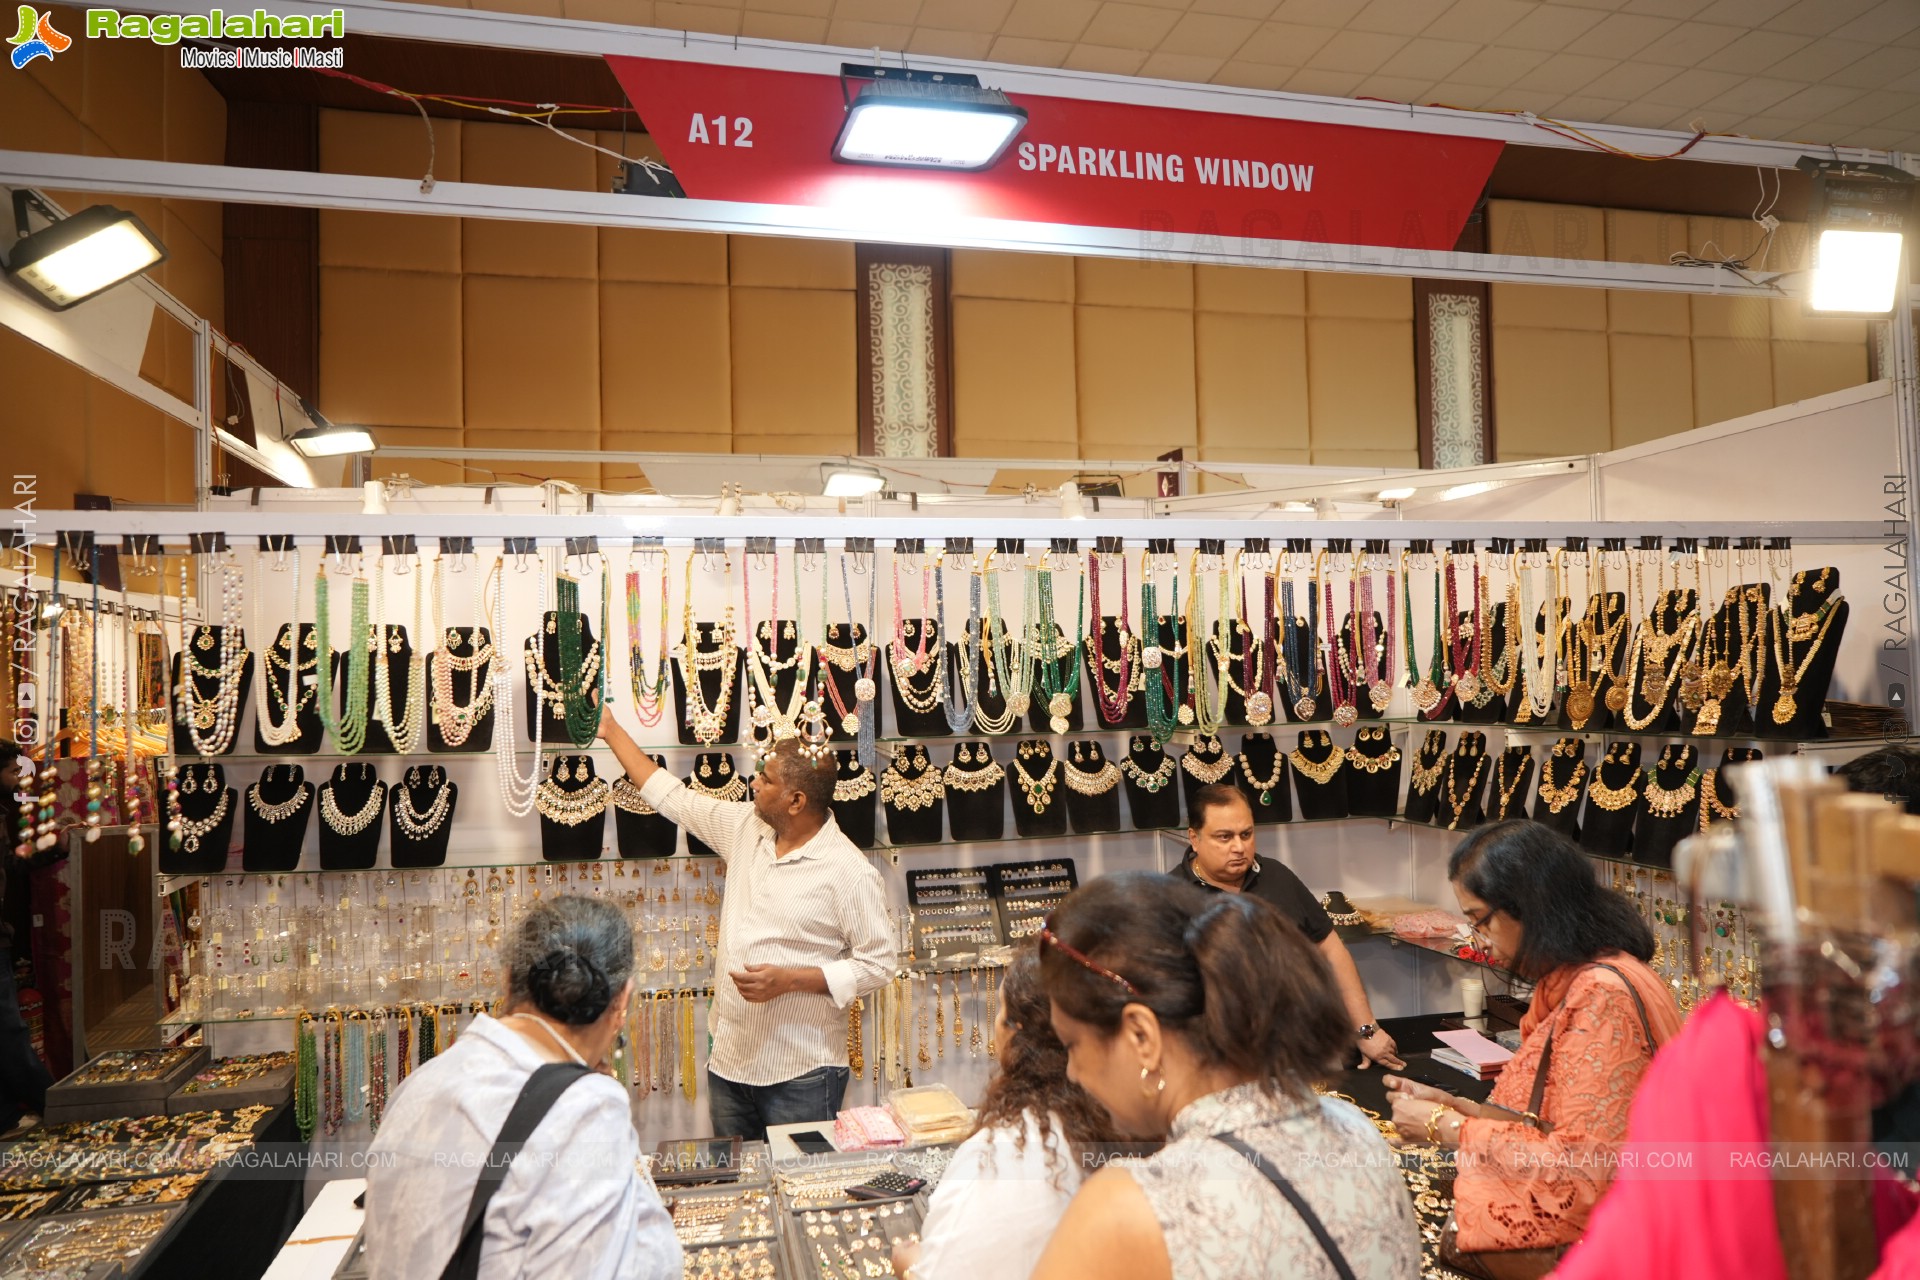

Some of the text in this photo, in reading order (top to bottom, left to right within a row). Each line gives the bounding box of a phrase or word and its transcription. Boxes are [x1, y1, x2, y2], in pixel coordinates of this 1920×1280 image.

[688, 112, 753, 148] A12
[1018, 141, 1314, 192] SPARKLING WINDOW
